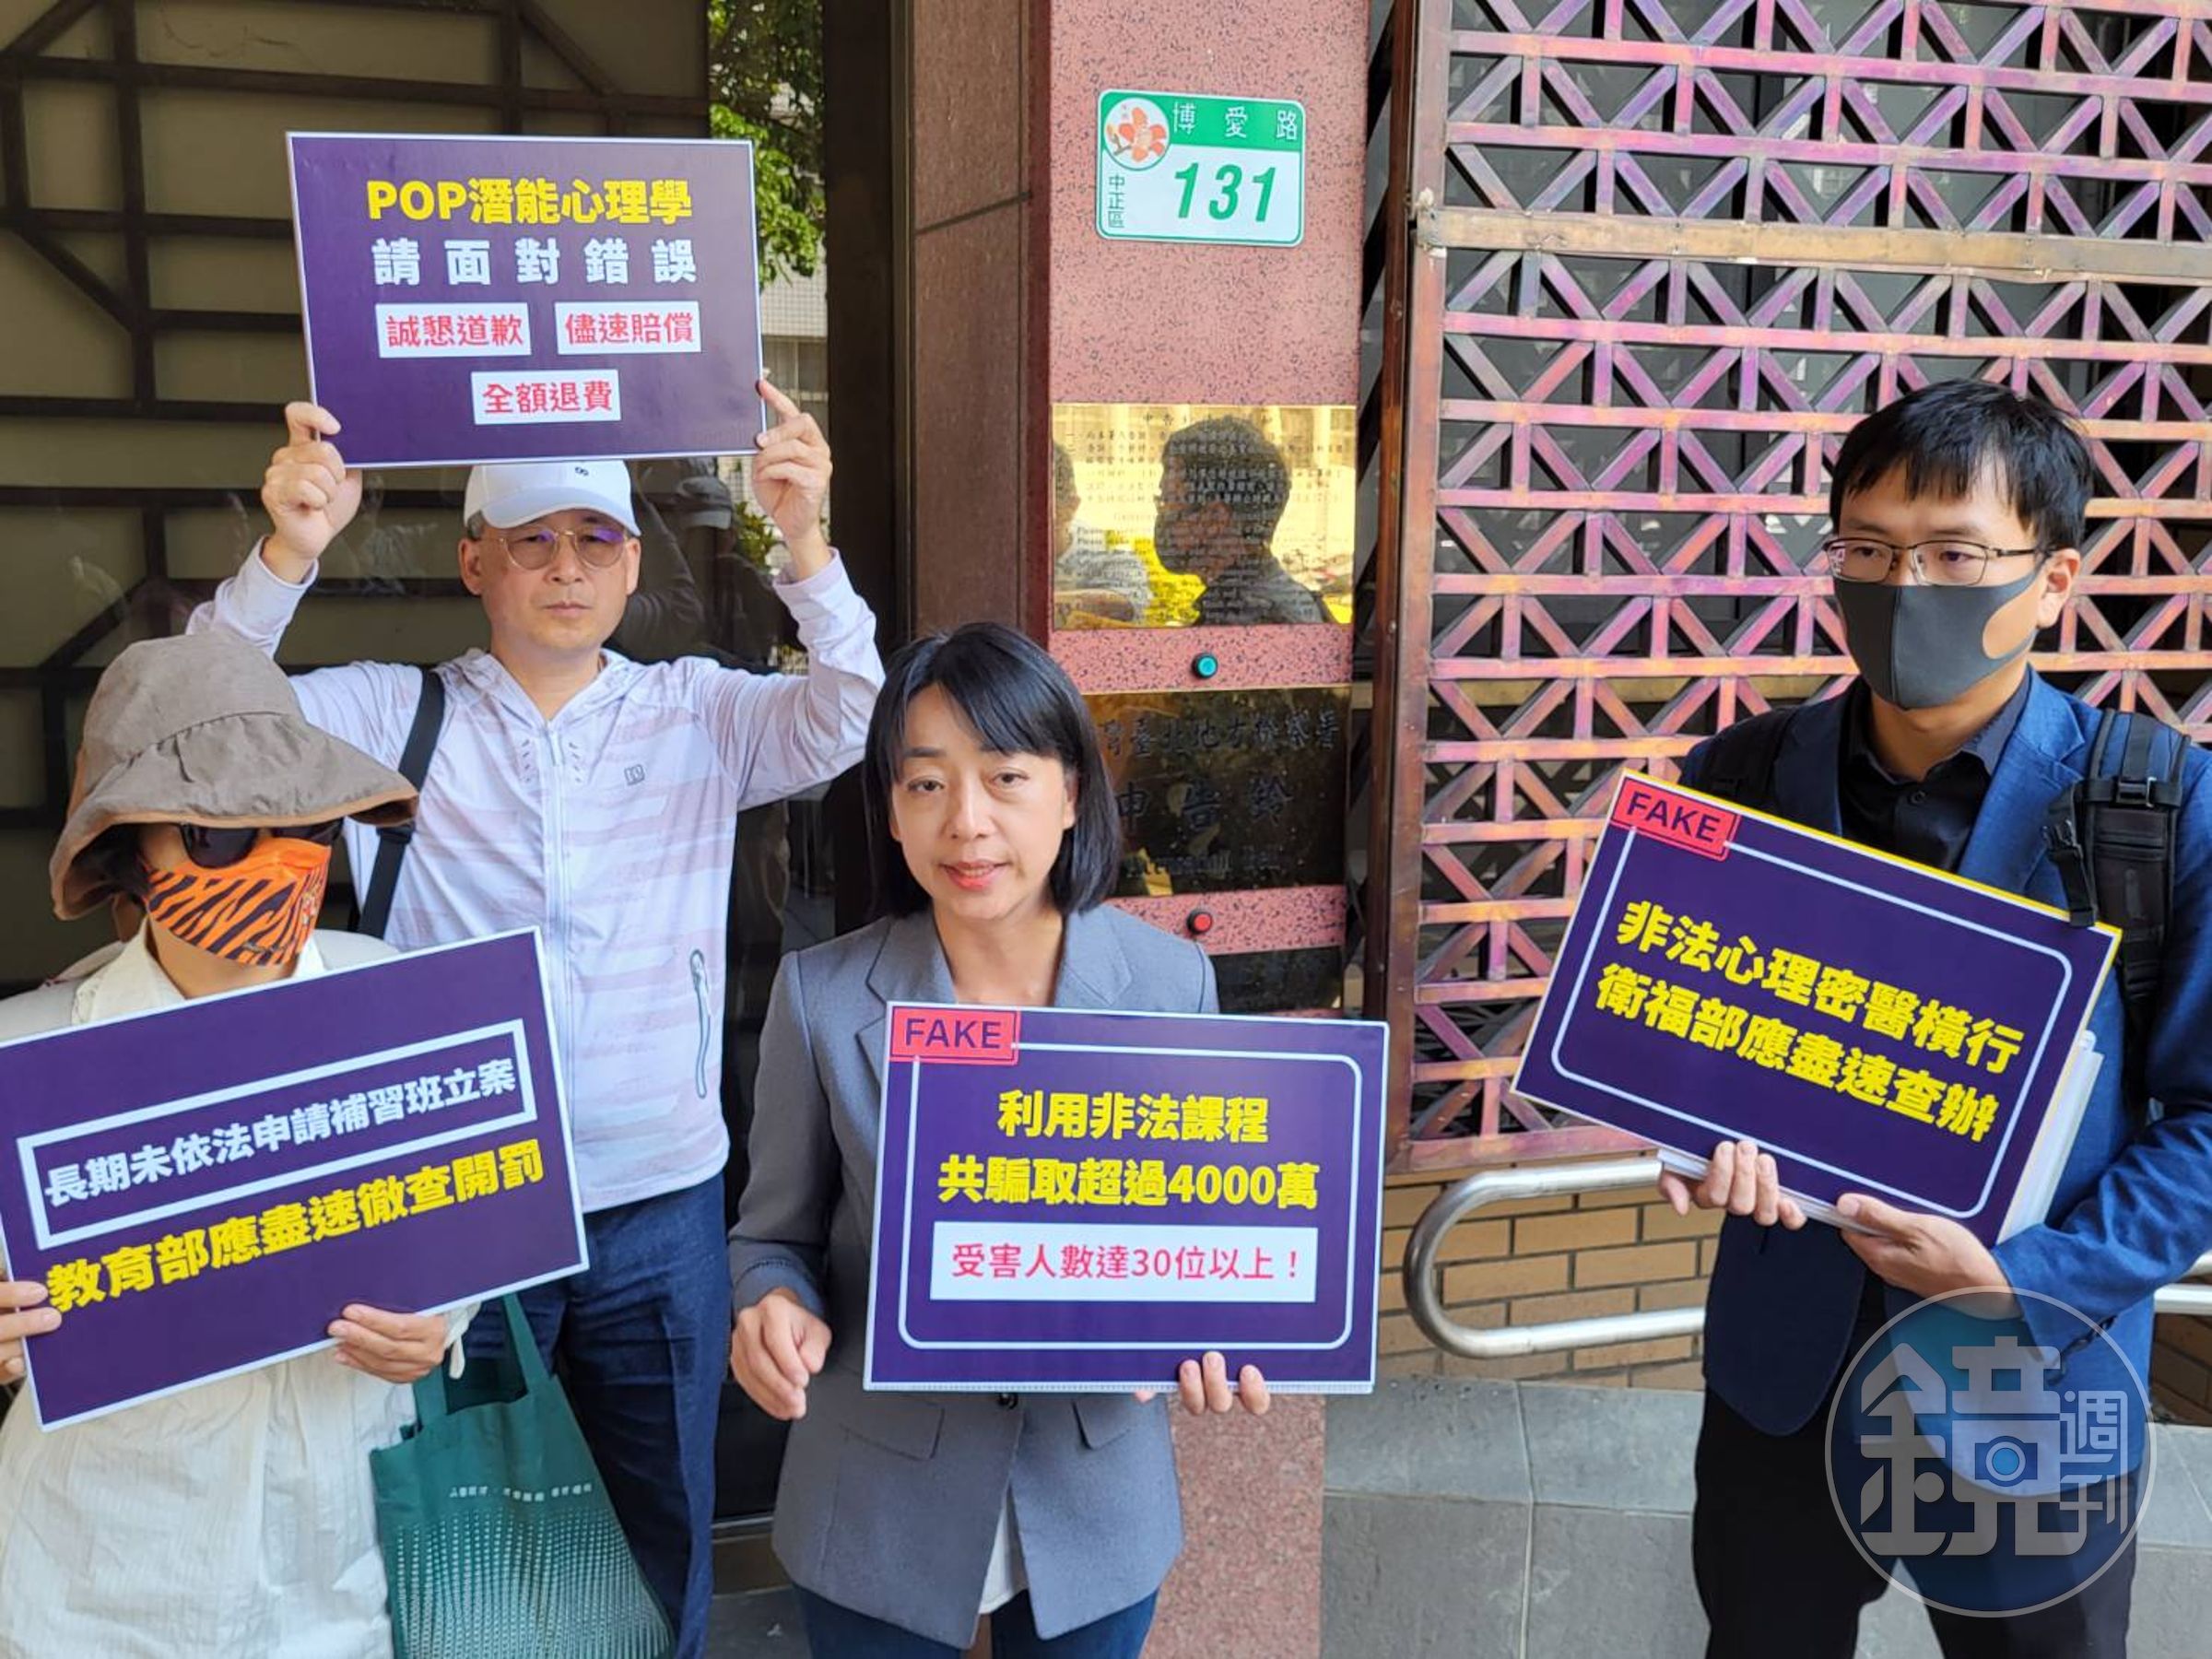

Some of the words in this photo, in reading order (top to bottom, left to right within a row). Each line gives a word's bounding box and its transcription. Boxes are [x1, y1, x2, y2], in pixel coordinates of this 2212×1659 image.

[1173, 102, 1299, 142] 博愛路
[367, 178, 693, 226] POP潛能心理學
[1108, 174, 1125, 228] 中正區
[1175, 162, 1277, 222] 131
[387, 315, 524, 347] 誠懇道歉
[565, 312, 695, 345] 儘速賠償
[482, 382, 613, 415] 全額退費
[1627, 791, 1722, 843] FAKE
[1616, 900, 2025, 1074] 非法心理密醫橫行
[905, 1018, 1002, 1049] FAKE
[1595, 962, 2000, 1142] 衛福部應盡速查辦
[44, 1057, 517, 1208] 長期未依法申請補習班立案
[998, 1089, 1269, 1143] 利用非法課程
[937, 1154, 1320, 1209] 共騙取超過4000萬
[46, 1139, 545, 1313] 教育部應盡速徹查開罰
